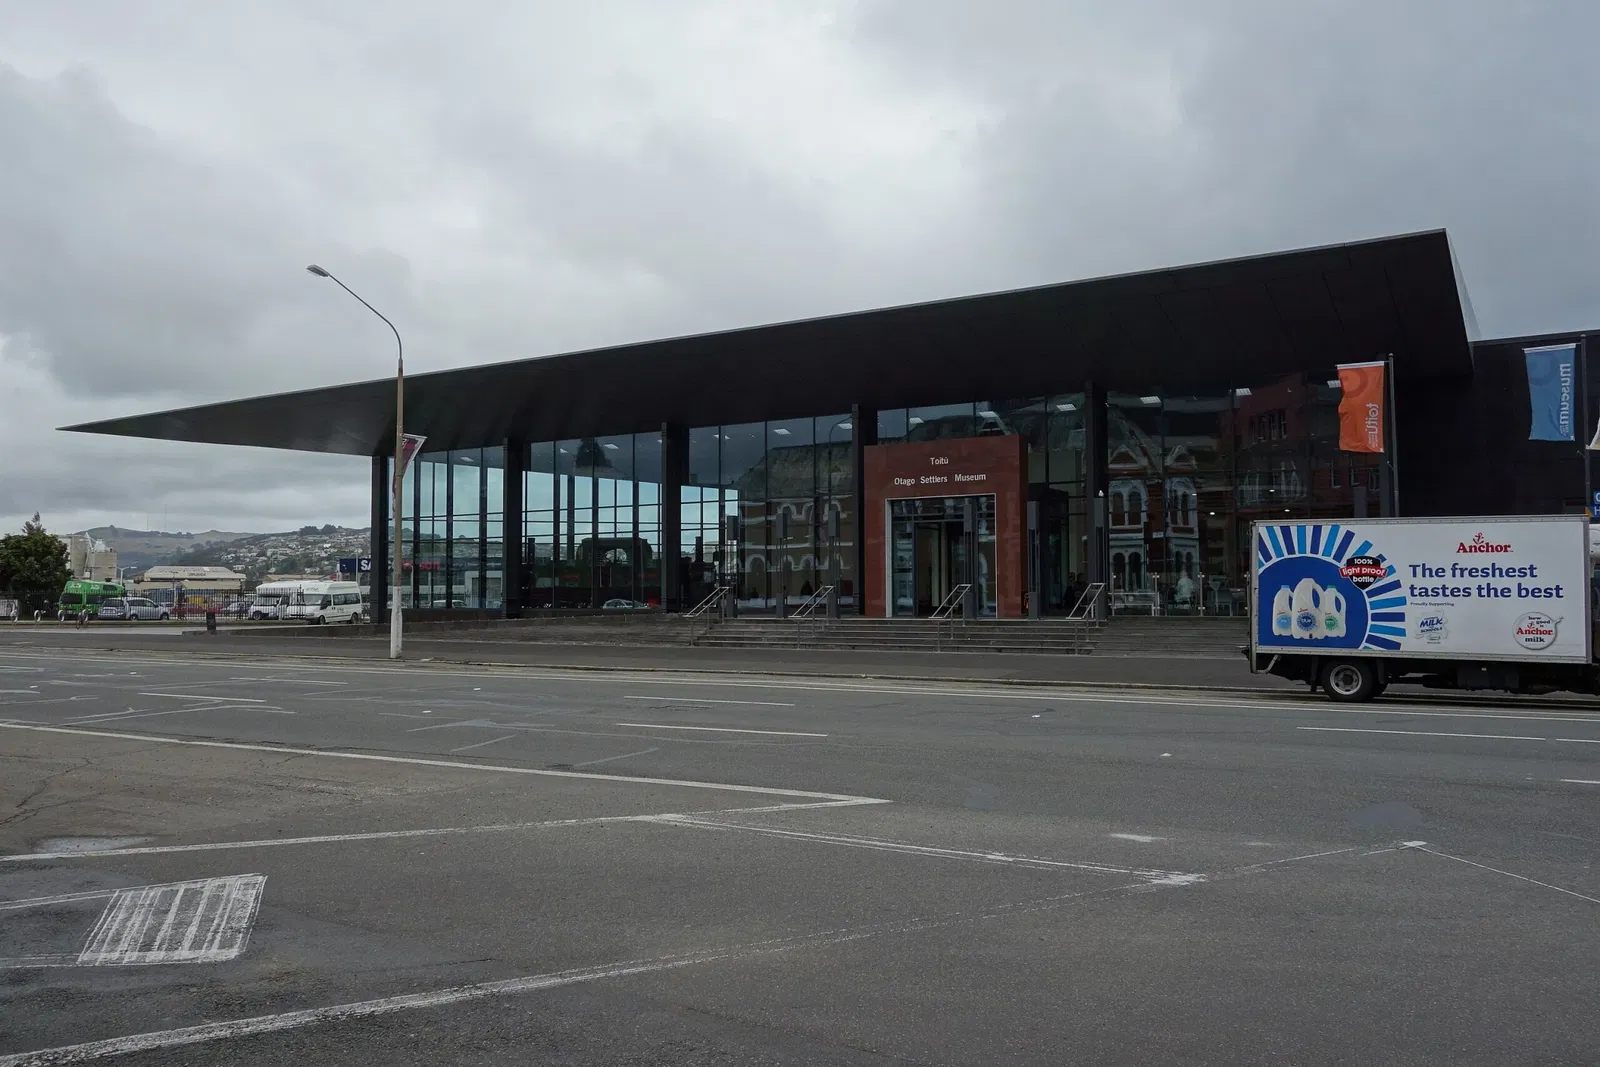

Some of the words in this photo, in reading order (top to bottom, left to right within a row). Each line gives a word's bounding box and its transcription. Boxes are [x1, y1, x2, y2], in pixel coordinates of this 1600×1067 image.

[894, 477, 916, 487] Otago
[920, 475, 948, 484] Settlers
[954, 473, 987, 482] Museum
[1456, 541, 1512, 553] Anchor
[1342, 567, 1360, 576] light
[1361, 567, 1386, 576] proof
[1409, 563, 1446, 578] The
[1450, 562, 1538, 578] freshest
[1352, 575, 1375, 583] bottle
[1409, 583, 1472, 598] tastes
[1476, 582, 1512, 598] the
[1517, 582, 1564, 598] best
[1420, 618, 1443, 628] MILK
[1516, 627, 1554, 636] Anchor
